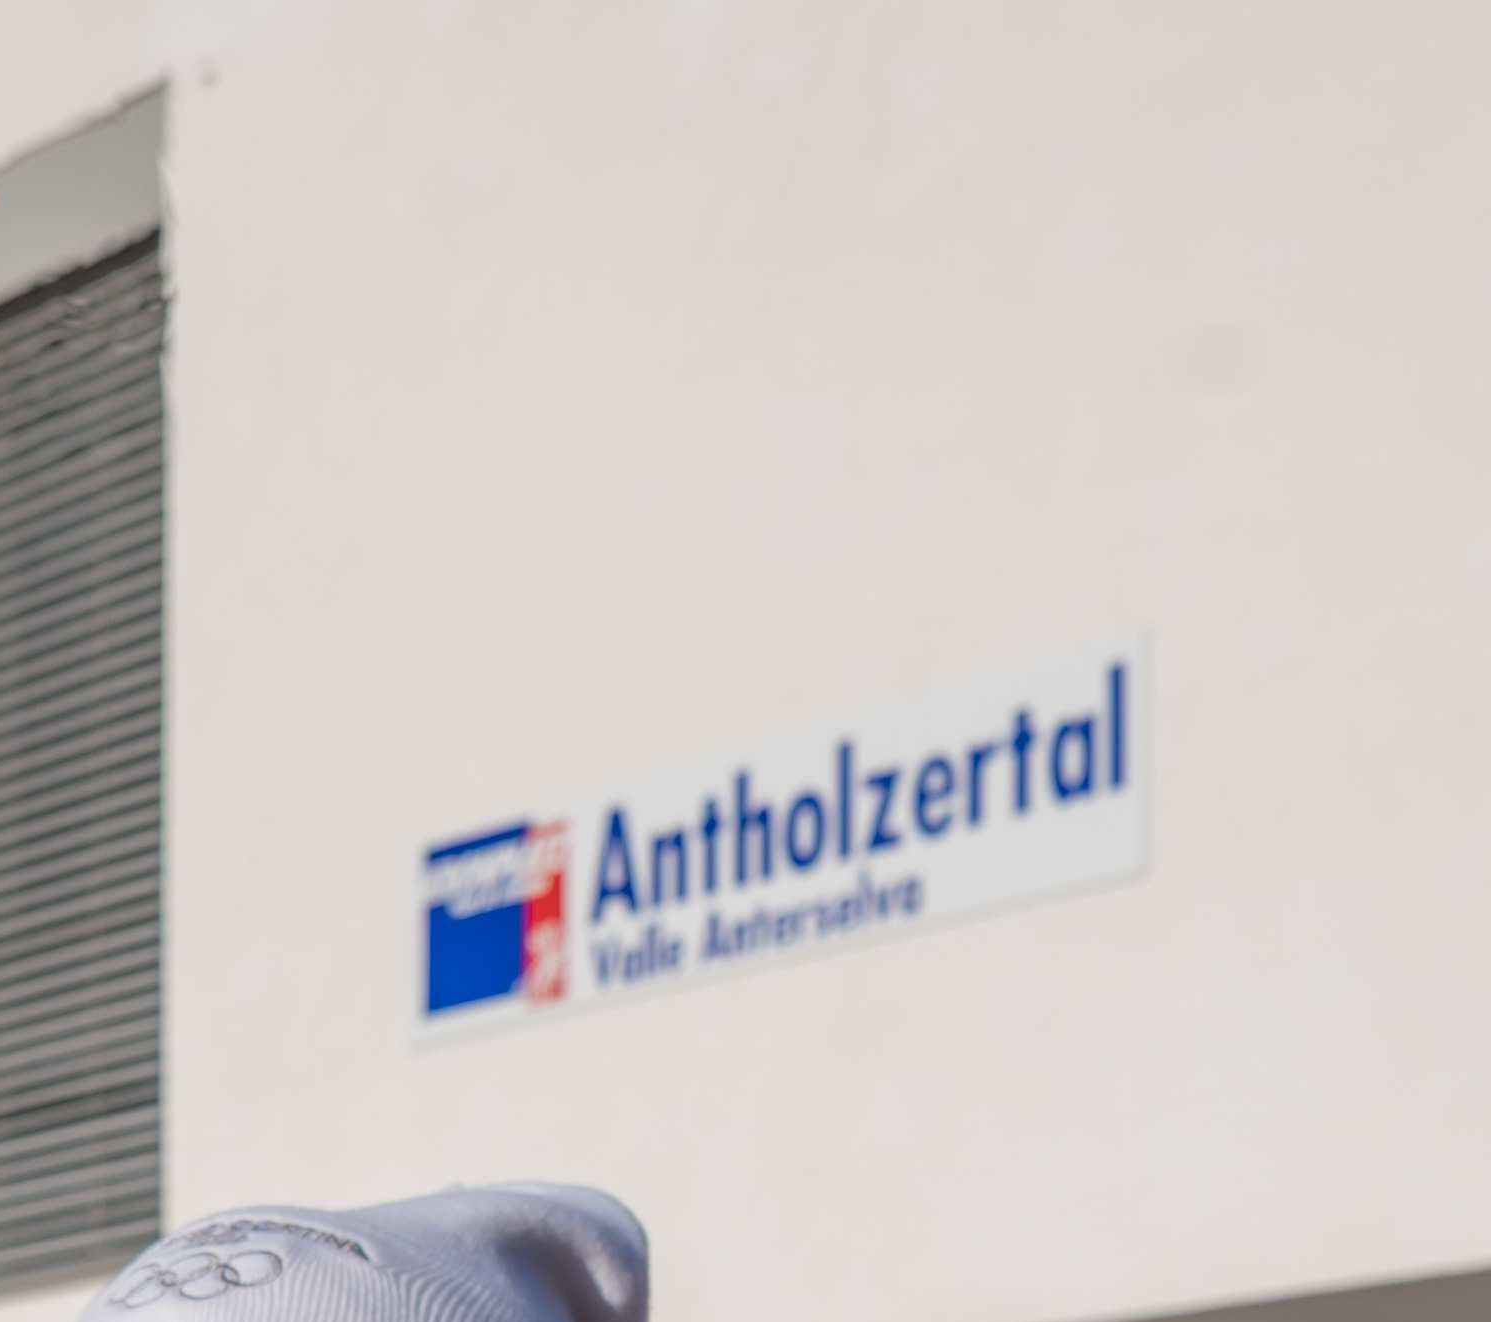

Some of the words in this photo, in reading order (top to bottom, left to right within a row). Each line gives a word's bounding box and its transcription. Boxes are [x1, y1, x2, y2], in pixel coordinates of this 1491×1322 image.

[590, 661, 1127, 926] Antholzertal
[593, 924, 682, 984] Valle
[702, 873, 923, 962] Anterselva
